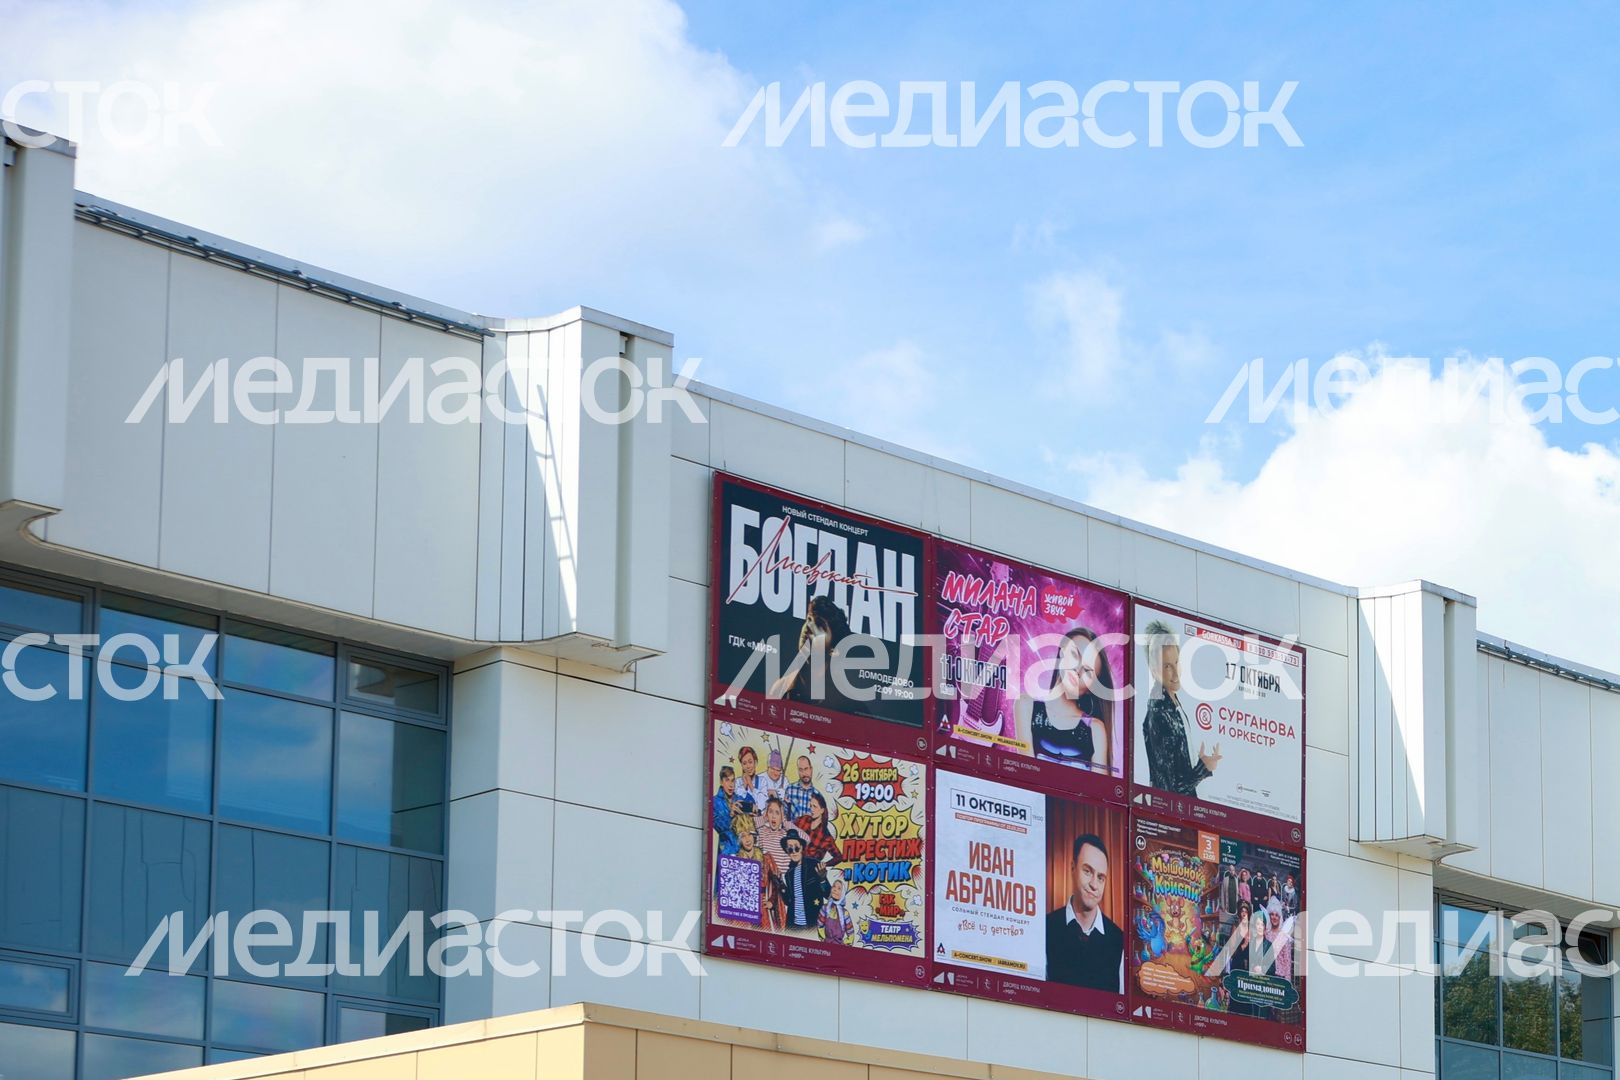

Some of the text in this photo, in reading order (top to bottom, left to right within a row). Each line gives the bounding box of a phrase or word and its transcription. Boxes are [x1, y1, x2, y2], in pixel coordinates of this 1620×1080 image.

[782, 505, 869, 537] НОВЫЙ СТЕНДАП КОНЦЕРТ
[729, 503, 916, 646] БОГДАН
[942, 571, 1037, 619] МИЛАНА
[943, 608, 1010, 648] СТАР
[728, 634, 746, 648] ГДК
[858, 669, 914, 689] ДОМОДЕДОВО
[955, 656, 1007, 690] ОКТЯБРЯ
[1225, 662, 1236, 681] 17
[1240, 665, 1280, 693] ОКТЯБРЯ
[894, 688, 914, 700] 19:00
[1219, 707, 1295, 739] СУРГАНОВА
[1219, 724, 1276, 748] И ОРКЕСТР
[842, 763, 898, 783] 26 СЕНТЯБРЯ
[855, 783, 894, 801] 19:00
[956, 794, 1027, 821] 11 ОКТЯБРЯ
[839, 813, 908, 839] ХУТОР
[842, 838, 922, 862] ПРЕСТИЖ
[1205, 839, 1212, 850] 3
[969, 840, 1014, 878] ИВАН
[853, 861, 912, 883] КОТИК
[945, 870, 1037, 917] АБРАМОВ
[951, 906, 1031, 926] СОЛЬНЫЙ СТЕНДАП КОНЦЕРТ
[871, 934, 913, 943] МЕЛЬПОМЕНА
[881, 925, 902, 934] ТЕАТР
[1237, 979, 1285, 997] Примадонны
